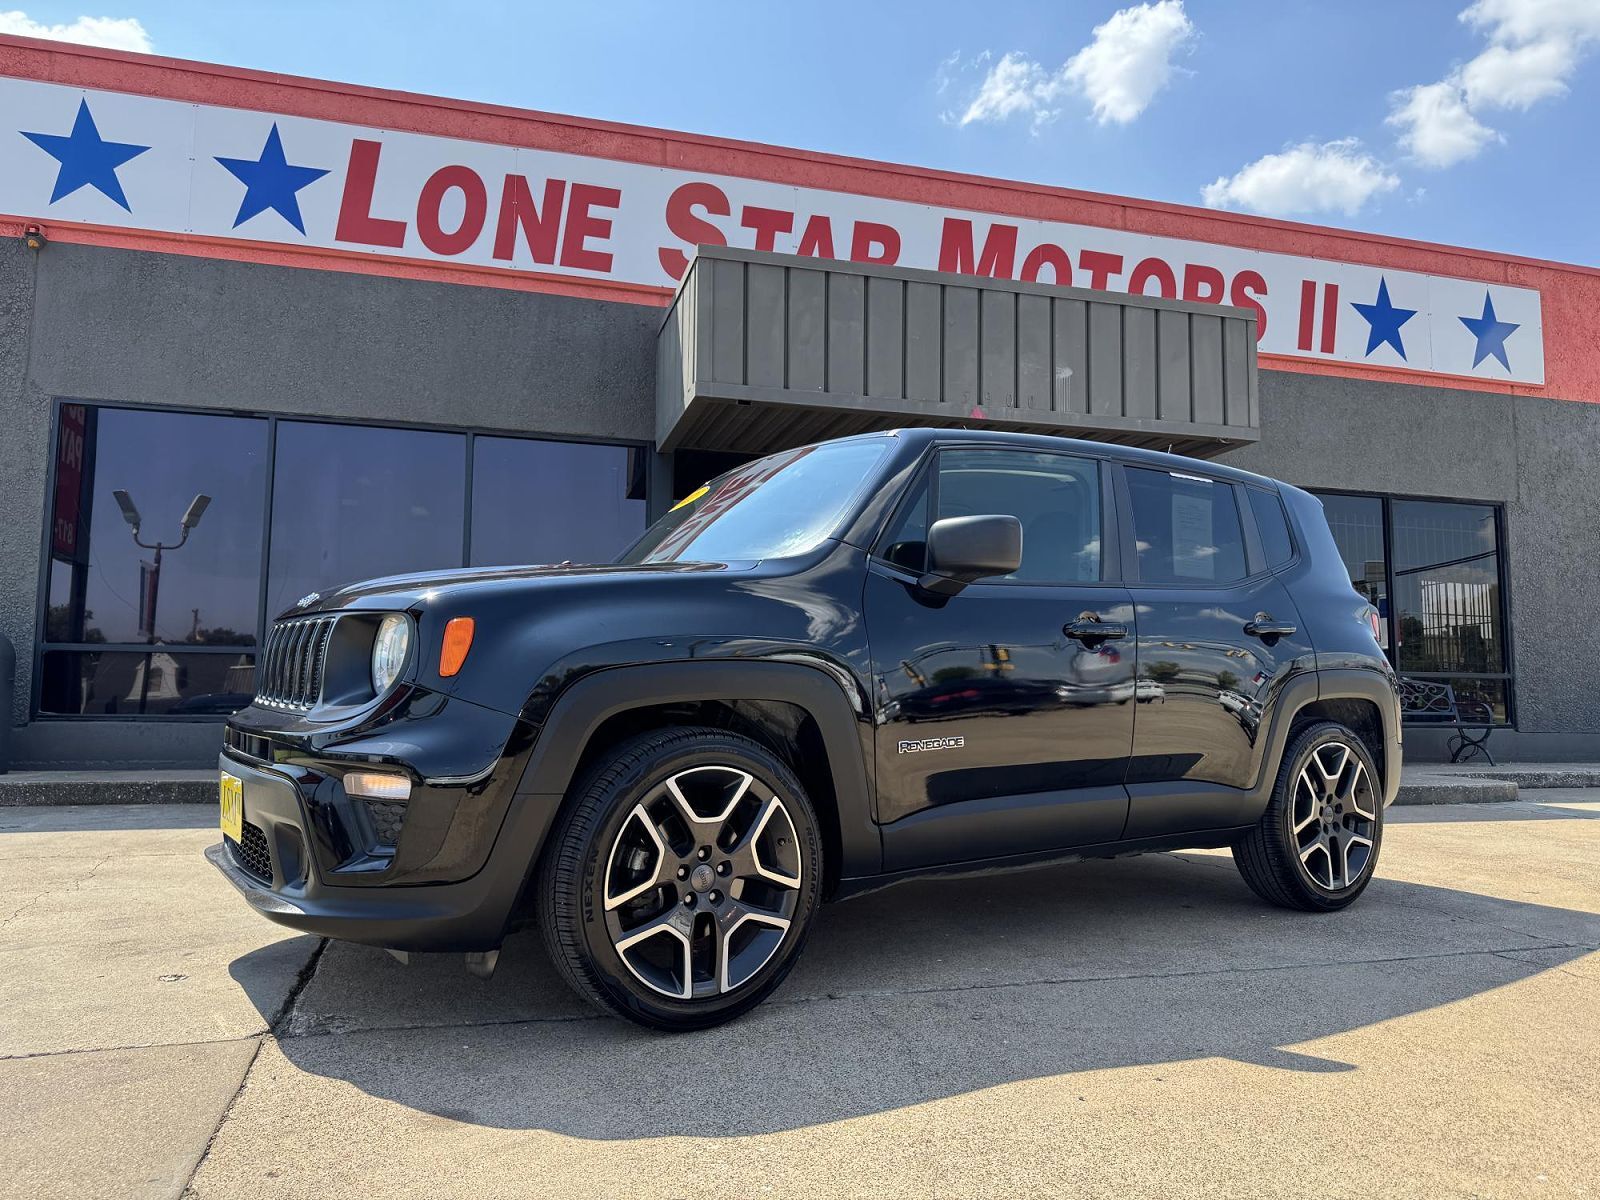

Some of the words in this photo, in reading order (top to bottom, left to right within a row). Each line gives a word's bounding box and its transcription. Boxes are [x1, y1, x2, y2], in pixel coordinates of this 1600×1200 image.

[335, 139, 622, 273] LONE
[658, 182, 901, 281] STAR
[938, 217, 1268, 342] MOTORS
[1297, 279, 1339, 354] II
[897, 736, 965, 754] RENEGADE
[584, 848, 600, 923] NEXEN
